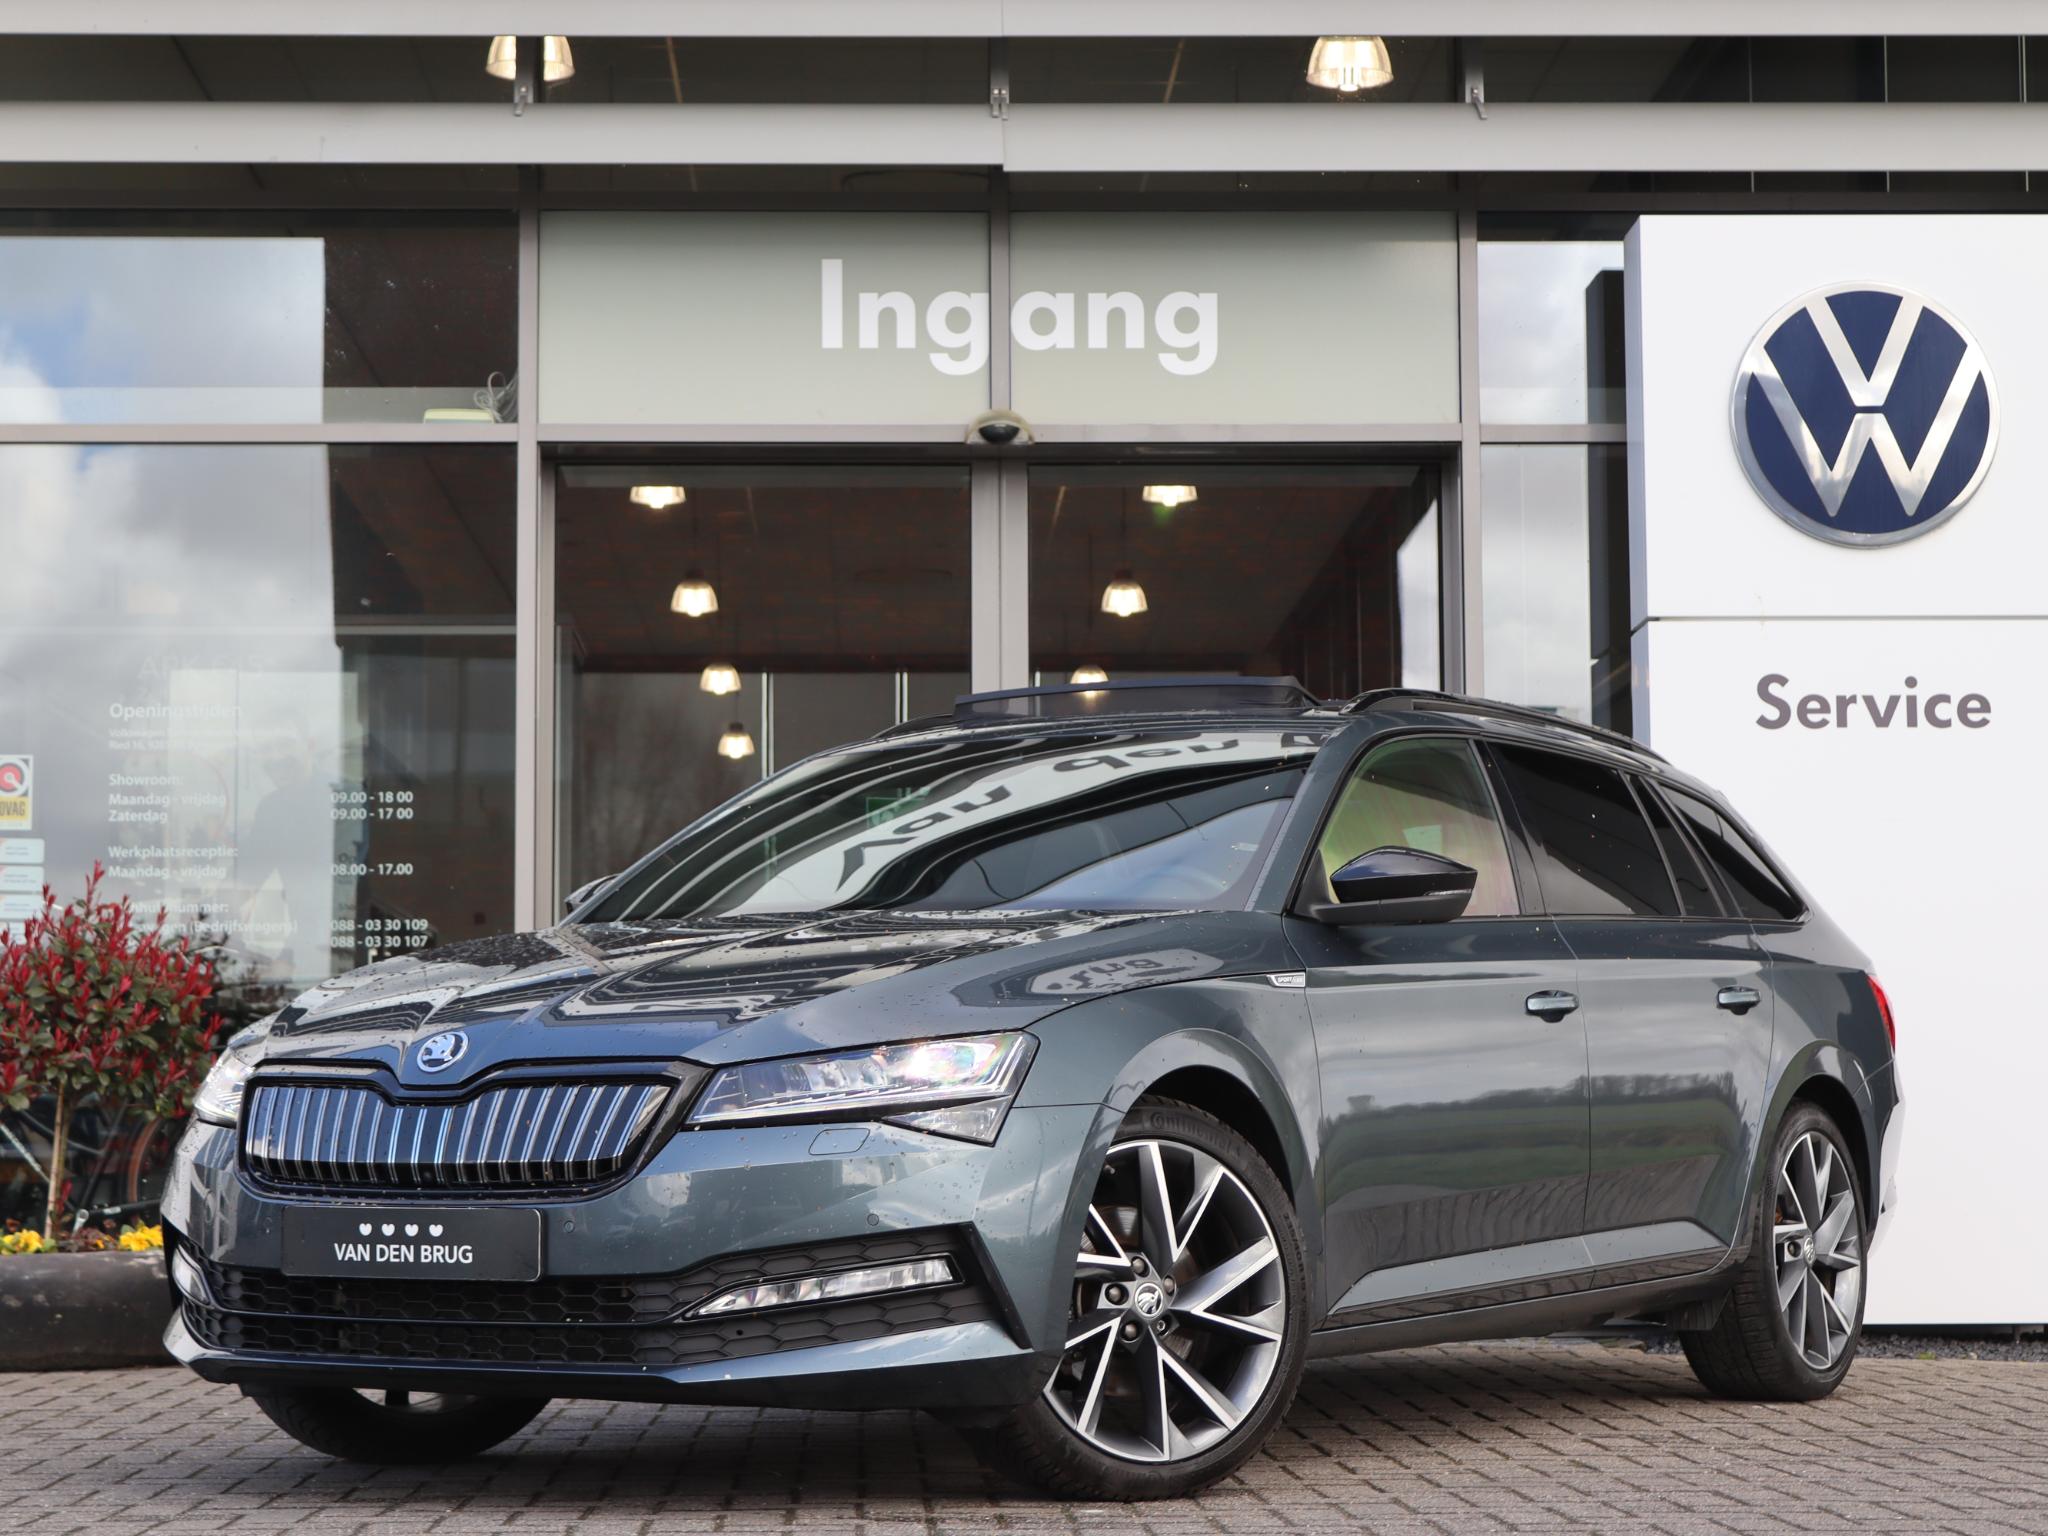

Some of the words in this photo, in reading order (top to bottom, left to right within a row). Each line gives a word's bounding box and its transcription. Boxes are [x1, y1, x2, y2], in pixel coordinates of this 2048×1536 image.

[820, 257, 1219, 376] Ingang
[1755, 673, 1992, 730] Service
[108, 773, 184, 787] Showroom:
[108, 793, 170, 808] Maandag
[181, 793, 227, 808] vrijdag
[329, 791, 367, 804] 09.00
[0, 800, 26, 817] OVAG
[329, 807, 367, 820] 09.00
[108, 809, 168, 824] Zaterdag
[108, 845, 239, 860] Werkplaatsreceptie:
[108, 866, 170, 881] Maandag
[181, 866, 227, 881] vrijdag
[329, 863, 367, 876] 08.00
[377, 863, 414, 876] 17.00
[329, 919, 355, 932] 088
[365, 919, 382, 932] 03
[384, 919, 401, 932] 30
[404, 919, 429, 932] 109
[329, 936, 355, 948] 088
[365, 936, 382, 948] 03
[384, 936, 401, 948] 30
[404, 936, 429, 948] 107
[334, 1243, 371, 1262] VAN
[375, 1244, 415, 1263] DEN
[420, 1245, 474, 1264] BRUG
